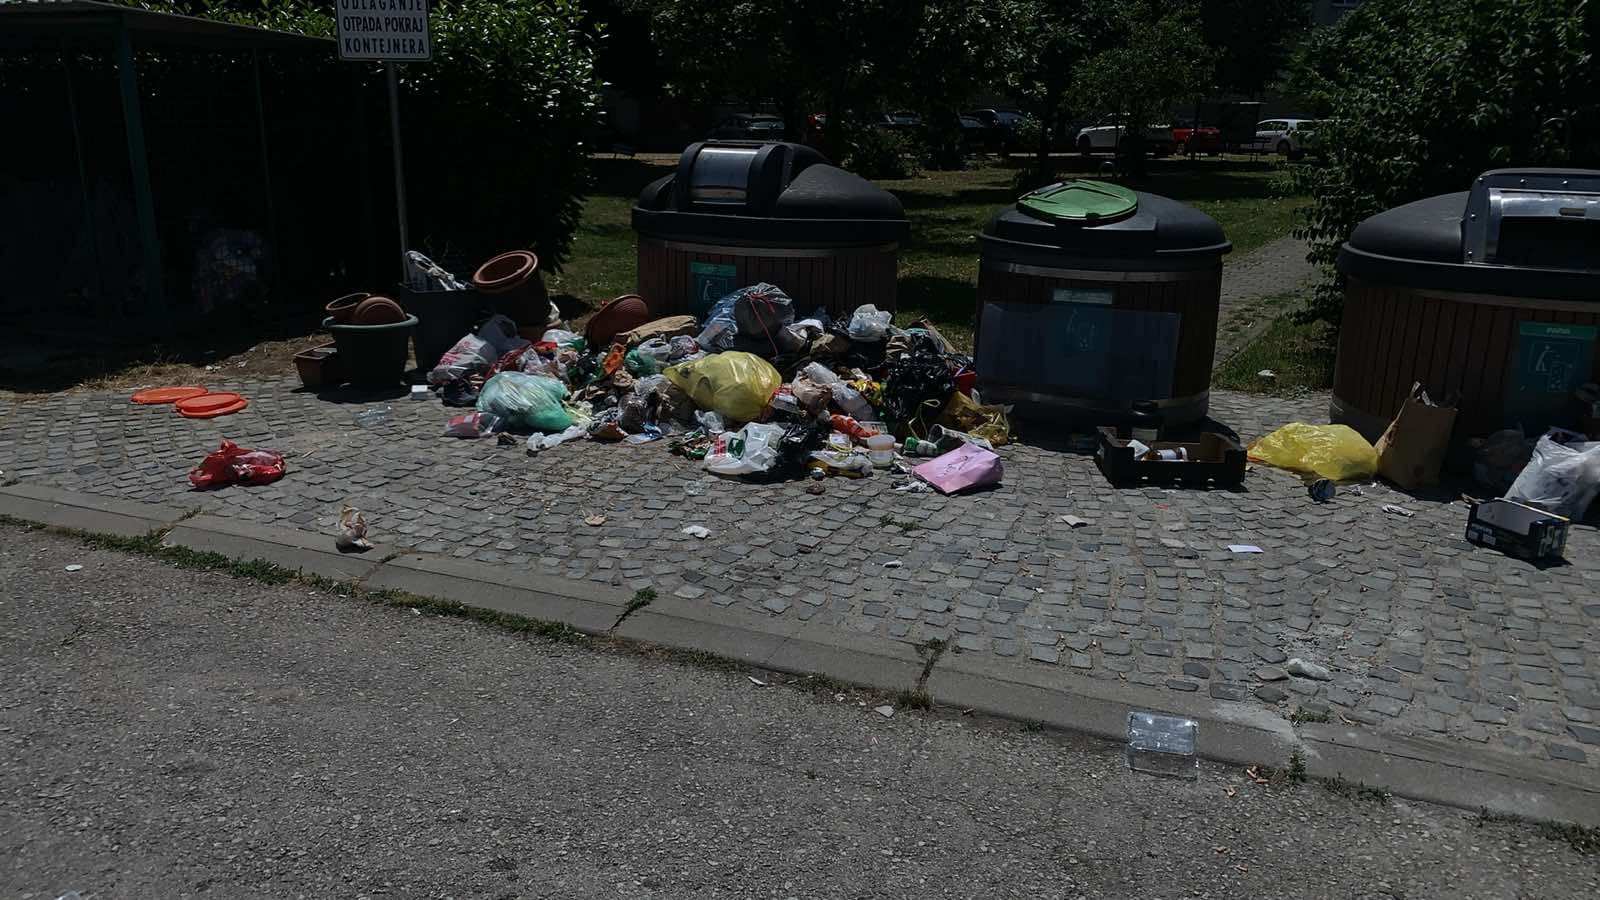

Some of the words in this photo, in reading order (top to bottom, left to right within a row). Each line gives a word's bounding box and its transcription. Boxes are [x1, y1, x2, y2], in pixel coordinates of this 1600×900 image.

[343, 16, 382, 32] OTPADA
[384, 17, 423, 32] POKRAJ
[345, 38, 425, 54] KONTEJNERA
